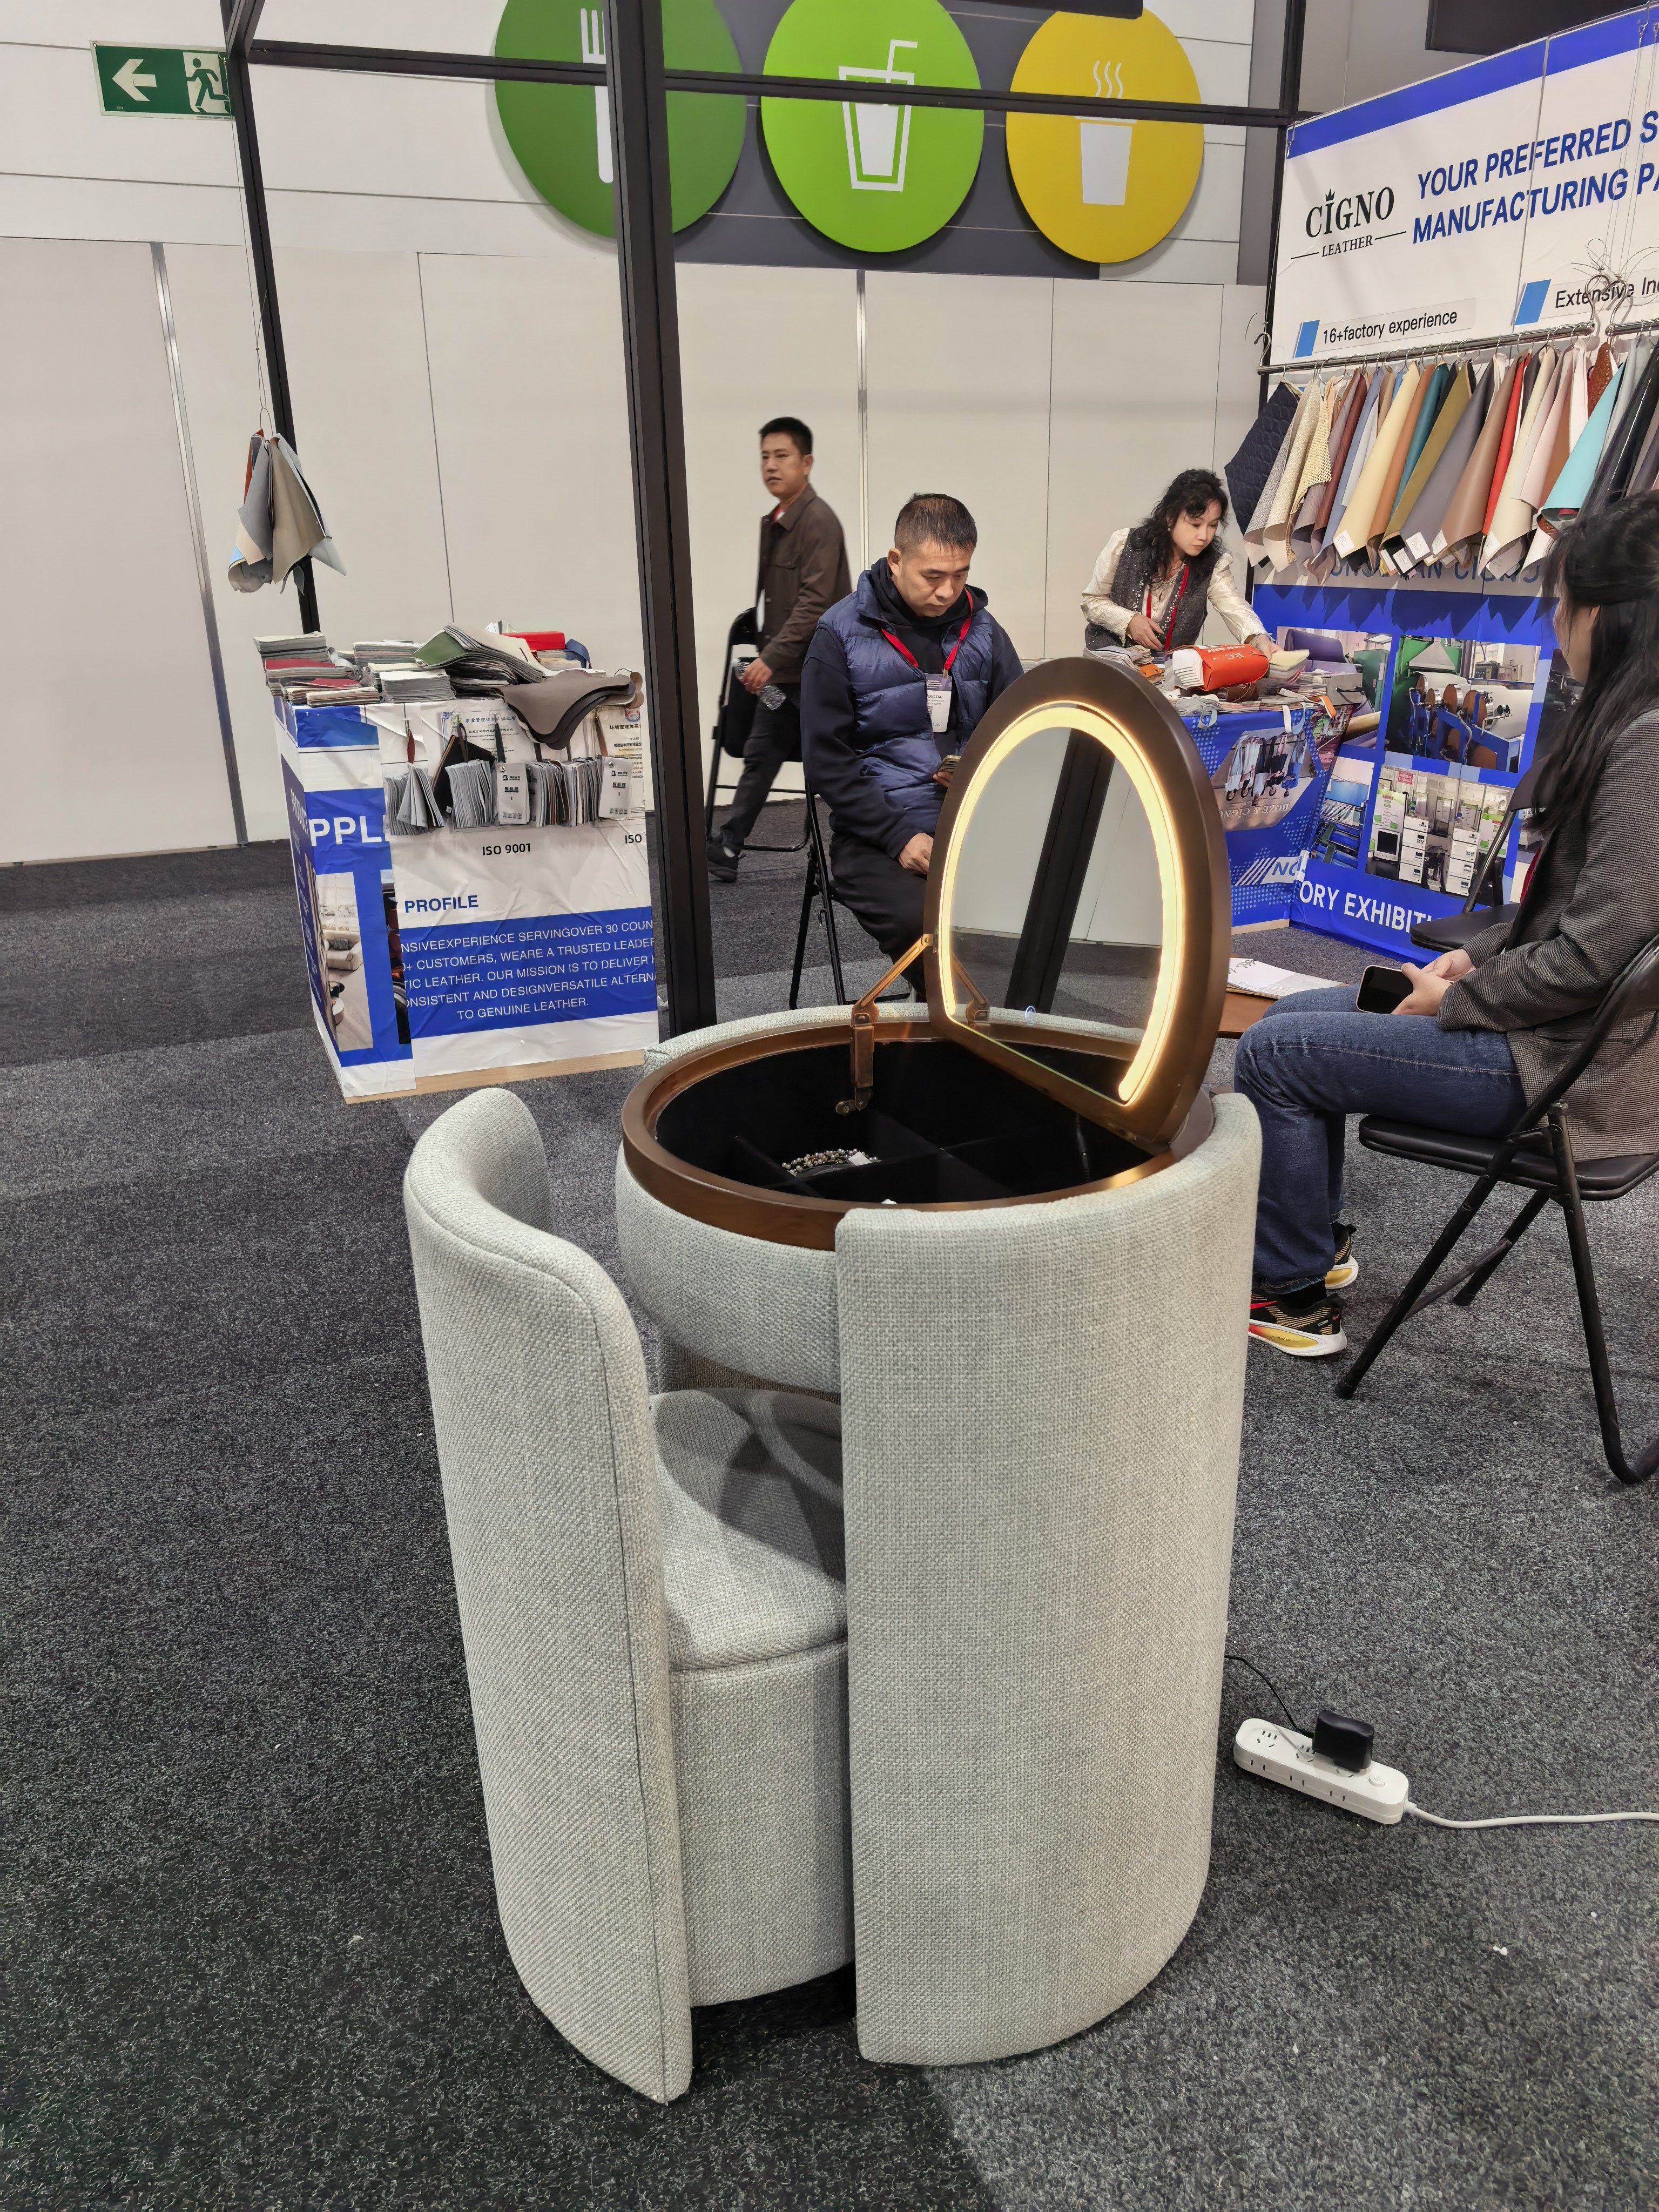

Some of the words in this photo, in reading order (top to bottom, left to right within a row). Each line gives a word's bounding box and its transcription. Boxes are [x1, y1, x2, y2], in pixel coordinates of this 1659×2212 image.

[1418, 159, 1478, 199] YOUR
[1485, 118, 1631, 182] PREFERRED
[1306, 187, 1394, 238] CIGNO
[1413, 168, 1628, 244] MANUFACTURING
[1321, 235, 1373, 257] LEATHER
[1555, 284, 1635, 308] Extensive
[1642, 277, 1659, 295] In
[1324, 323, 1385, 344] 16+factory
[1388, 311, 1458, 335] experience
[483, 846, 501, 855] ISO
[505, 843, 531, 854] 9001
[625, 834, 642, 844] ISO
[405, 895, 479, 913] PROFILE
[1299, 880, 1339, 911] ORY
[401, 933, 515, 953] NSIVEEXPERIENCE
[518, 925, 603, 942] SERVINGOVER
[606, 924, 618, 933] 30
[417, 953, 497, 970] CUSTOMERS,
[500, 948, 543, 961] WEARE
[547, 948, 555, 957] A
[557, 942, 611, 955] TRUSTED
[425, 973, 483, 988] LEATHER.
[487, 970, 513, 981] OUR
[517, 965, 565, 978] MISSION
[569, 963, 579, 972] IS
[582, 961, 598, 970] TO
[602, 956, 648, 969] DELIVER
[473, 989, 498, 1000] AND
[502, 977, 608, 997] DESIGNVERSATILE
[611, 973, 656, 985] ALTERN
[457, 1009, 474, 1020] TO
[478, 1003, 531, 1017] GENUINE
[534, 997, 589, 1011] LEATHER.
